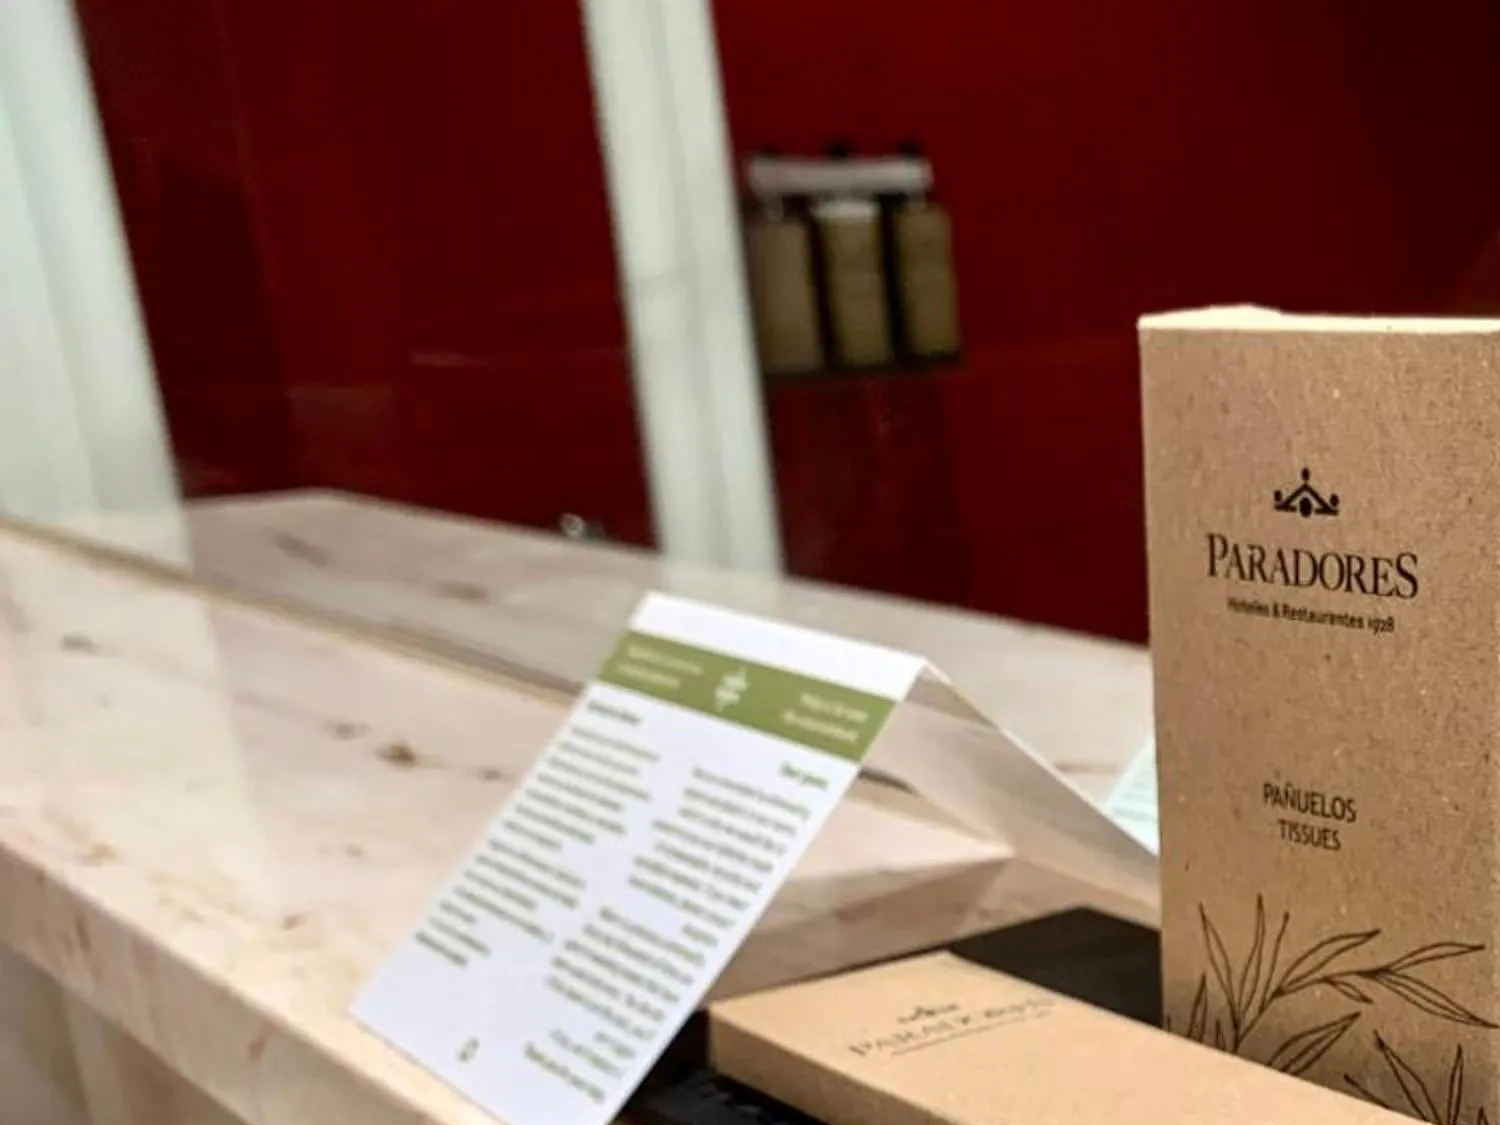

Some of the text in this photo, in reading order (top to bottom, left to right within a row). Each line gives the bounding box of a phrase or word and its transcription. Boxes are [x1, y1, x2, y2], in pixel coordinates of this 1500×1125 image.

[1206, 533, 1420, 599] PARADORES
[1282, 603, 1364, 630] Restaurantes
[1263, 781, 1357, 823] PAÑUELOS
[1278, 818, 1342, 851] TISSUES
